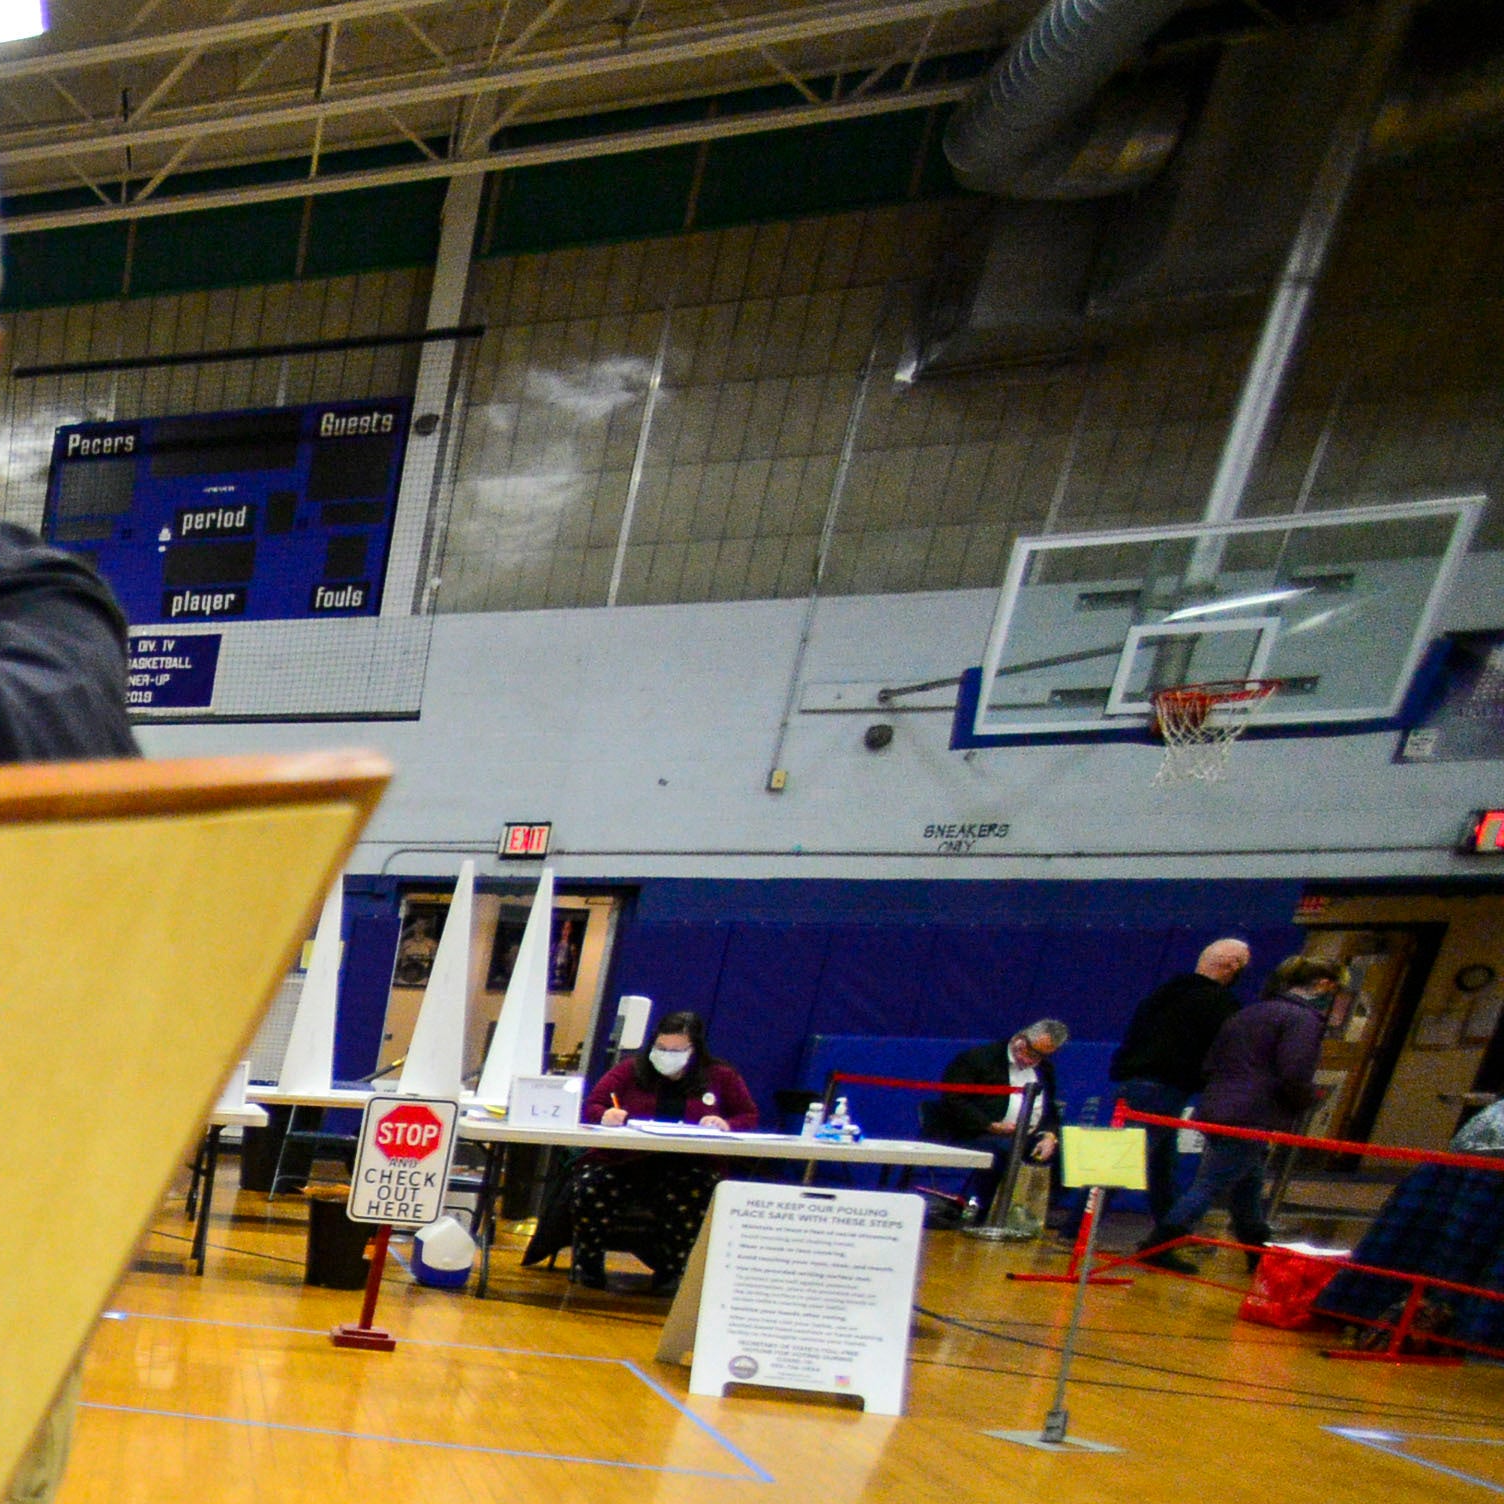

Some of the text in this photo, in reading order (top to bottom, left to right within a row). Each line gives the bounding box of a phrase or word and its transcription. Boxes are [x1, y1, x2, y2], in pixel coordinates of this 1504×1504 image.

[320, 411, 393, 438] Guests
[67, 432, 135, 457] Pacers
[182, 505, 247, 536] period
[171, 588, 236, 617] player
[314, 585, 363, 610] fouls
[138, 640, 157, 652] DIV.
[162, 639, 176, 652] IV
[509, 827, 546, 851] EXIT
[923, 823, 1010, 838] SNEAKERS
[378, 1122, 438, 1147] STOP
[389, 1157, 418, 1168] AND
[364, 1168, 436, 1187] CHECK
[377, 1185, 421, 1202] OUT
[367, 1200, 424, 1218] HERE
[730, 1208, 903, 1230] PLACE SAFE WITH THESE STEPS
[746, 1200, 888, 1217] HELP KEEP OUR POLLING
